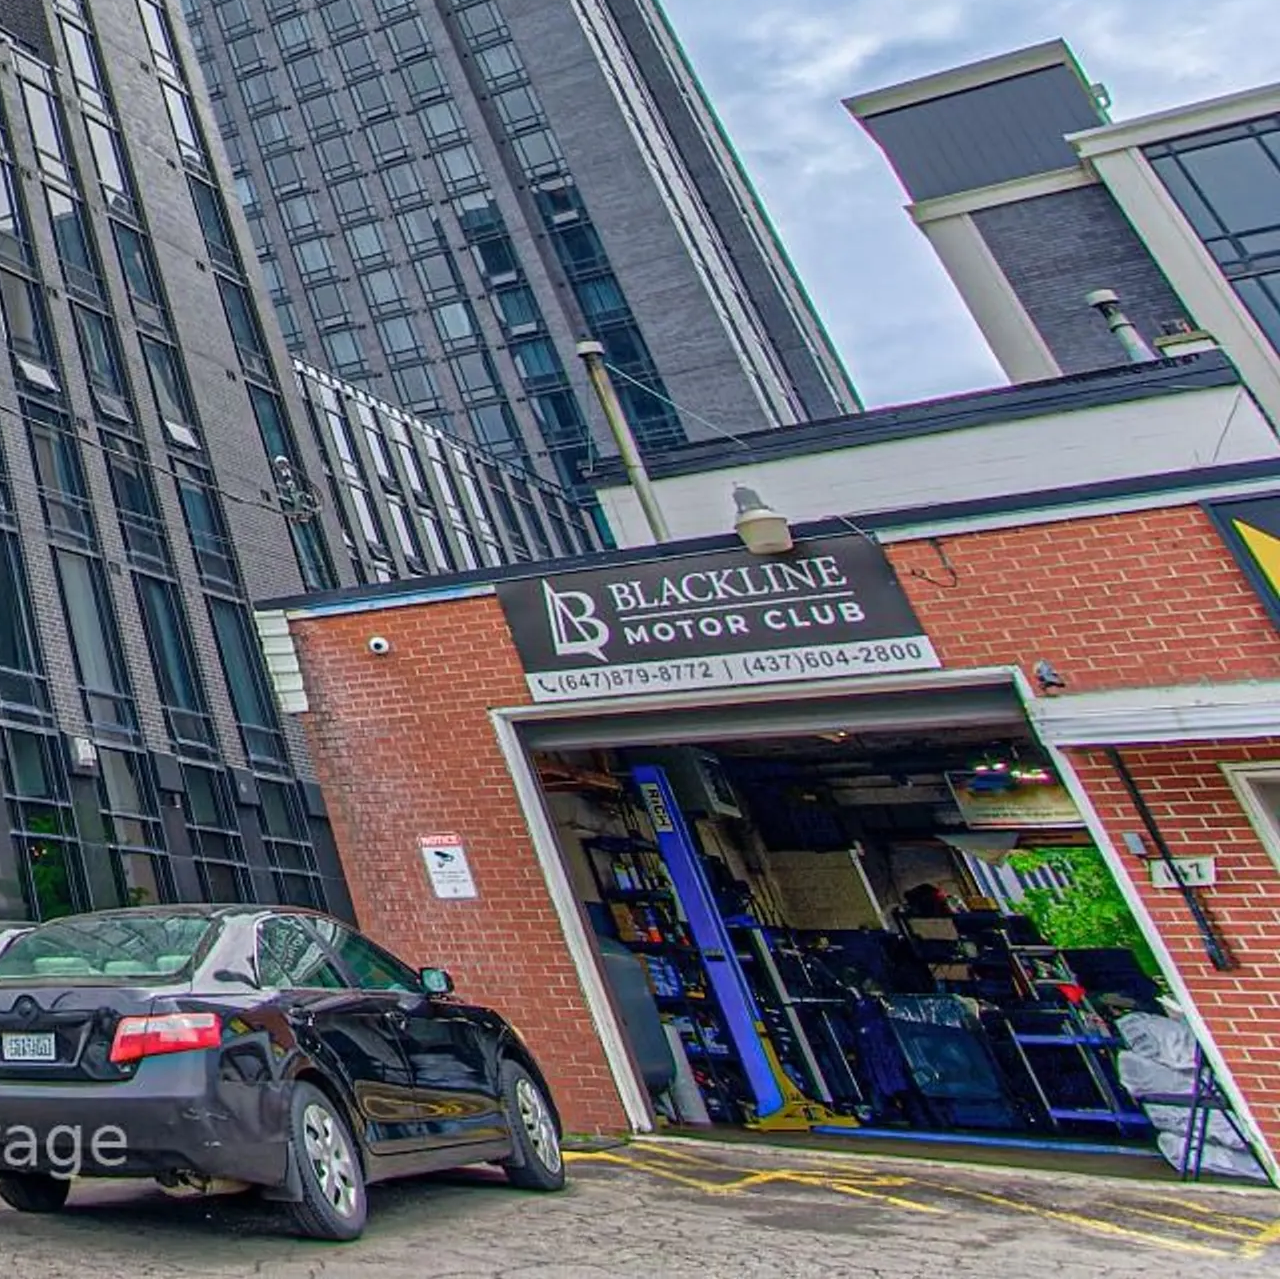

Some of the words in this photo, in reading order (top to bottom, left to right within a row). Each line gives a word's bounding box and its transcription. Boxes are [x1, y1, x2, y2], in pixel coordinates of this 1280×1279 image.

[607, 555, 848, 613] BLACKLINE
[623, 614, 750, 645] MOTOR
[763, 601, 866, 631] CLUB
[558, 661, 714, 694] (647)879-8772
[742, 642, 922, 677] (437)604-2800
